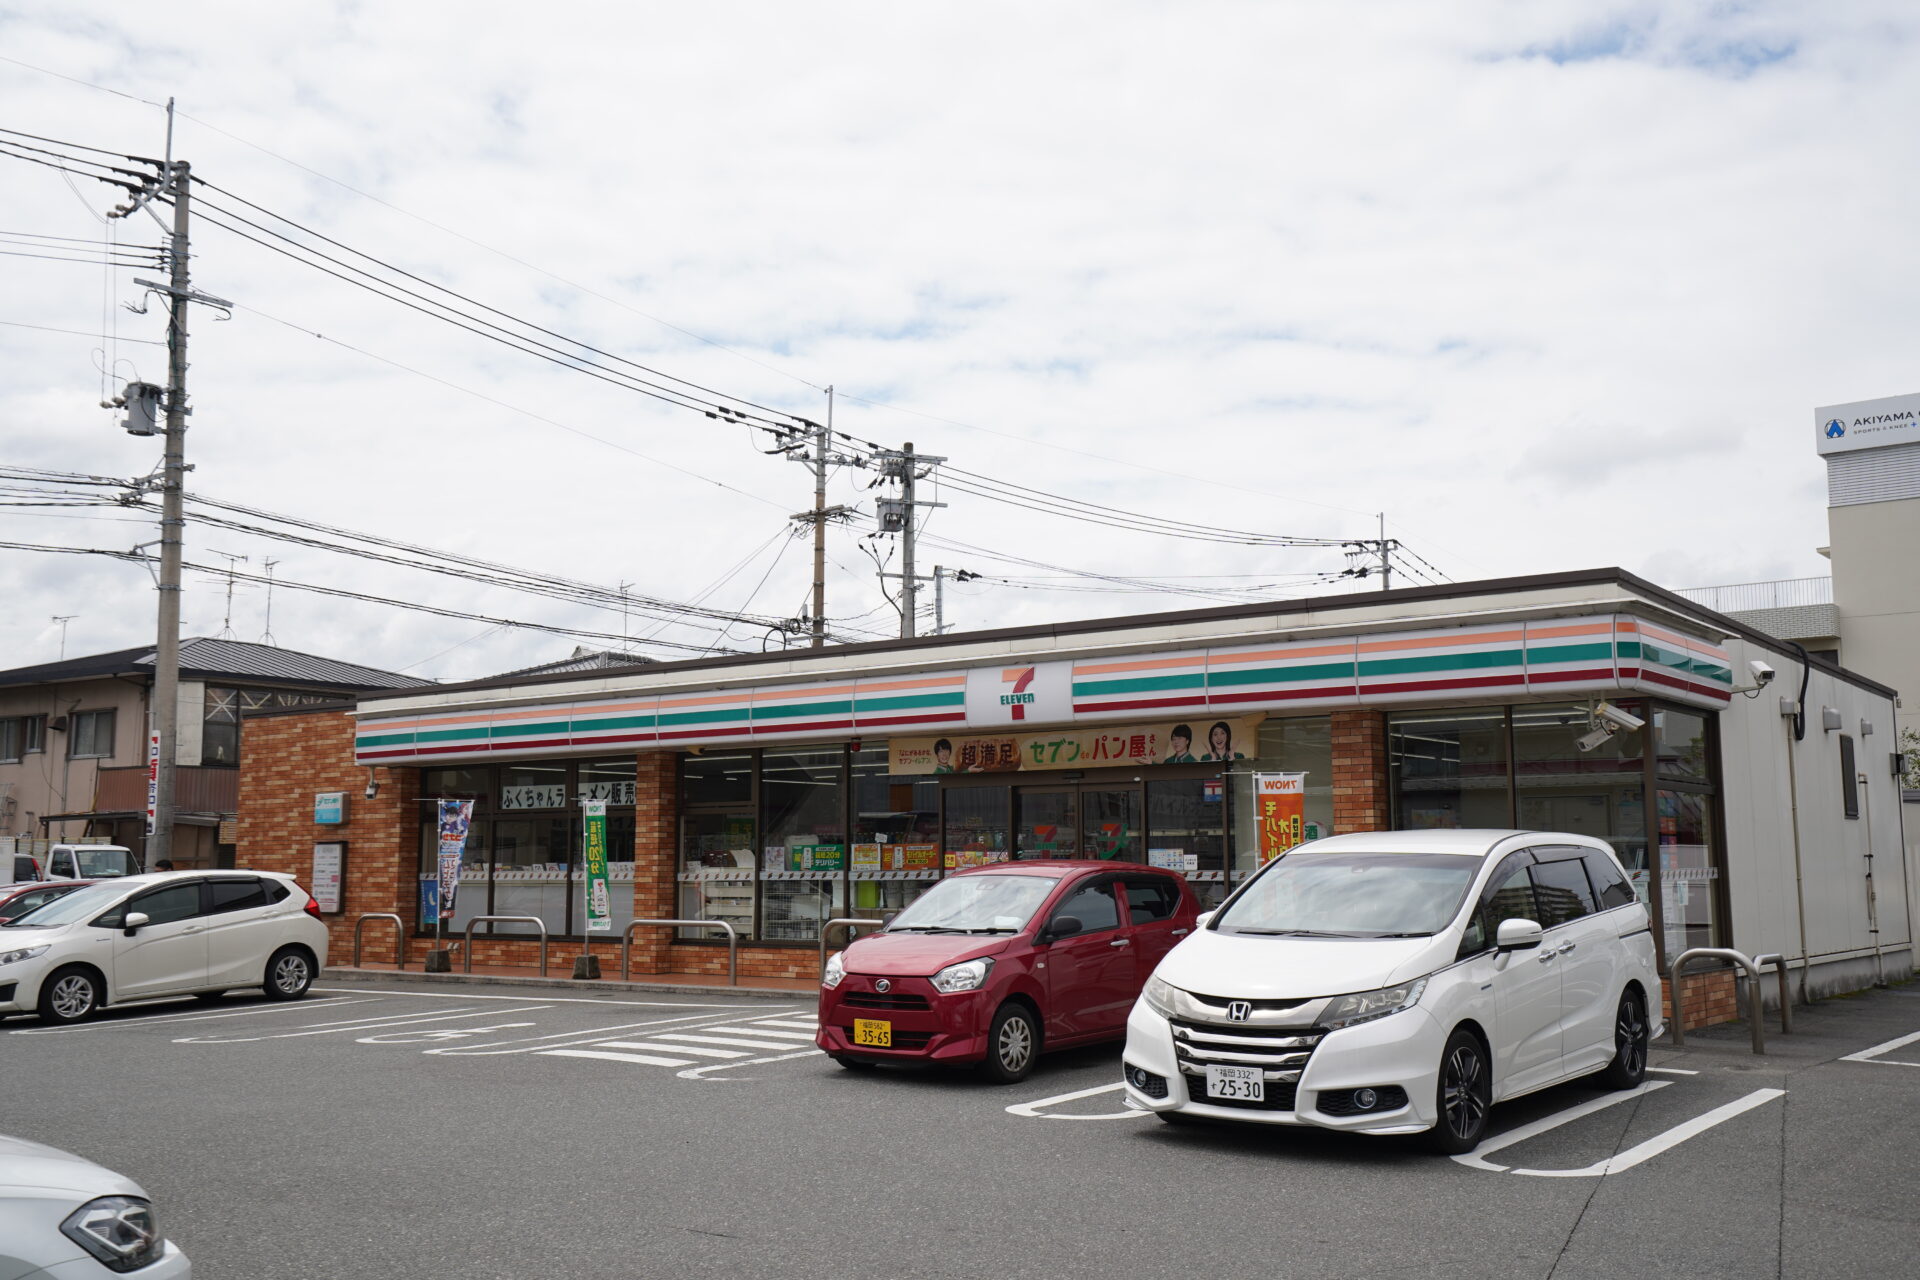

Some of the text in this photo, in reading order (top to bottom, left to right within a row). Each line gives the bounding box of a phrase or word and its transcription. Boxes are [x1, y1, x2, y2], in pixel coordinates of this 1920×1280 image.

[1853, 411, 1914, 427] AKIYAMA
[1002, 666, 1035, 720] 7
[961, 743, 1014, 766] 超満足
[862, 1029, 889, 1045] 35-65
[1219, 1078, 1260, 1098] 25-30
